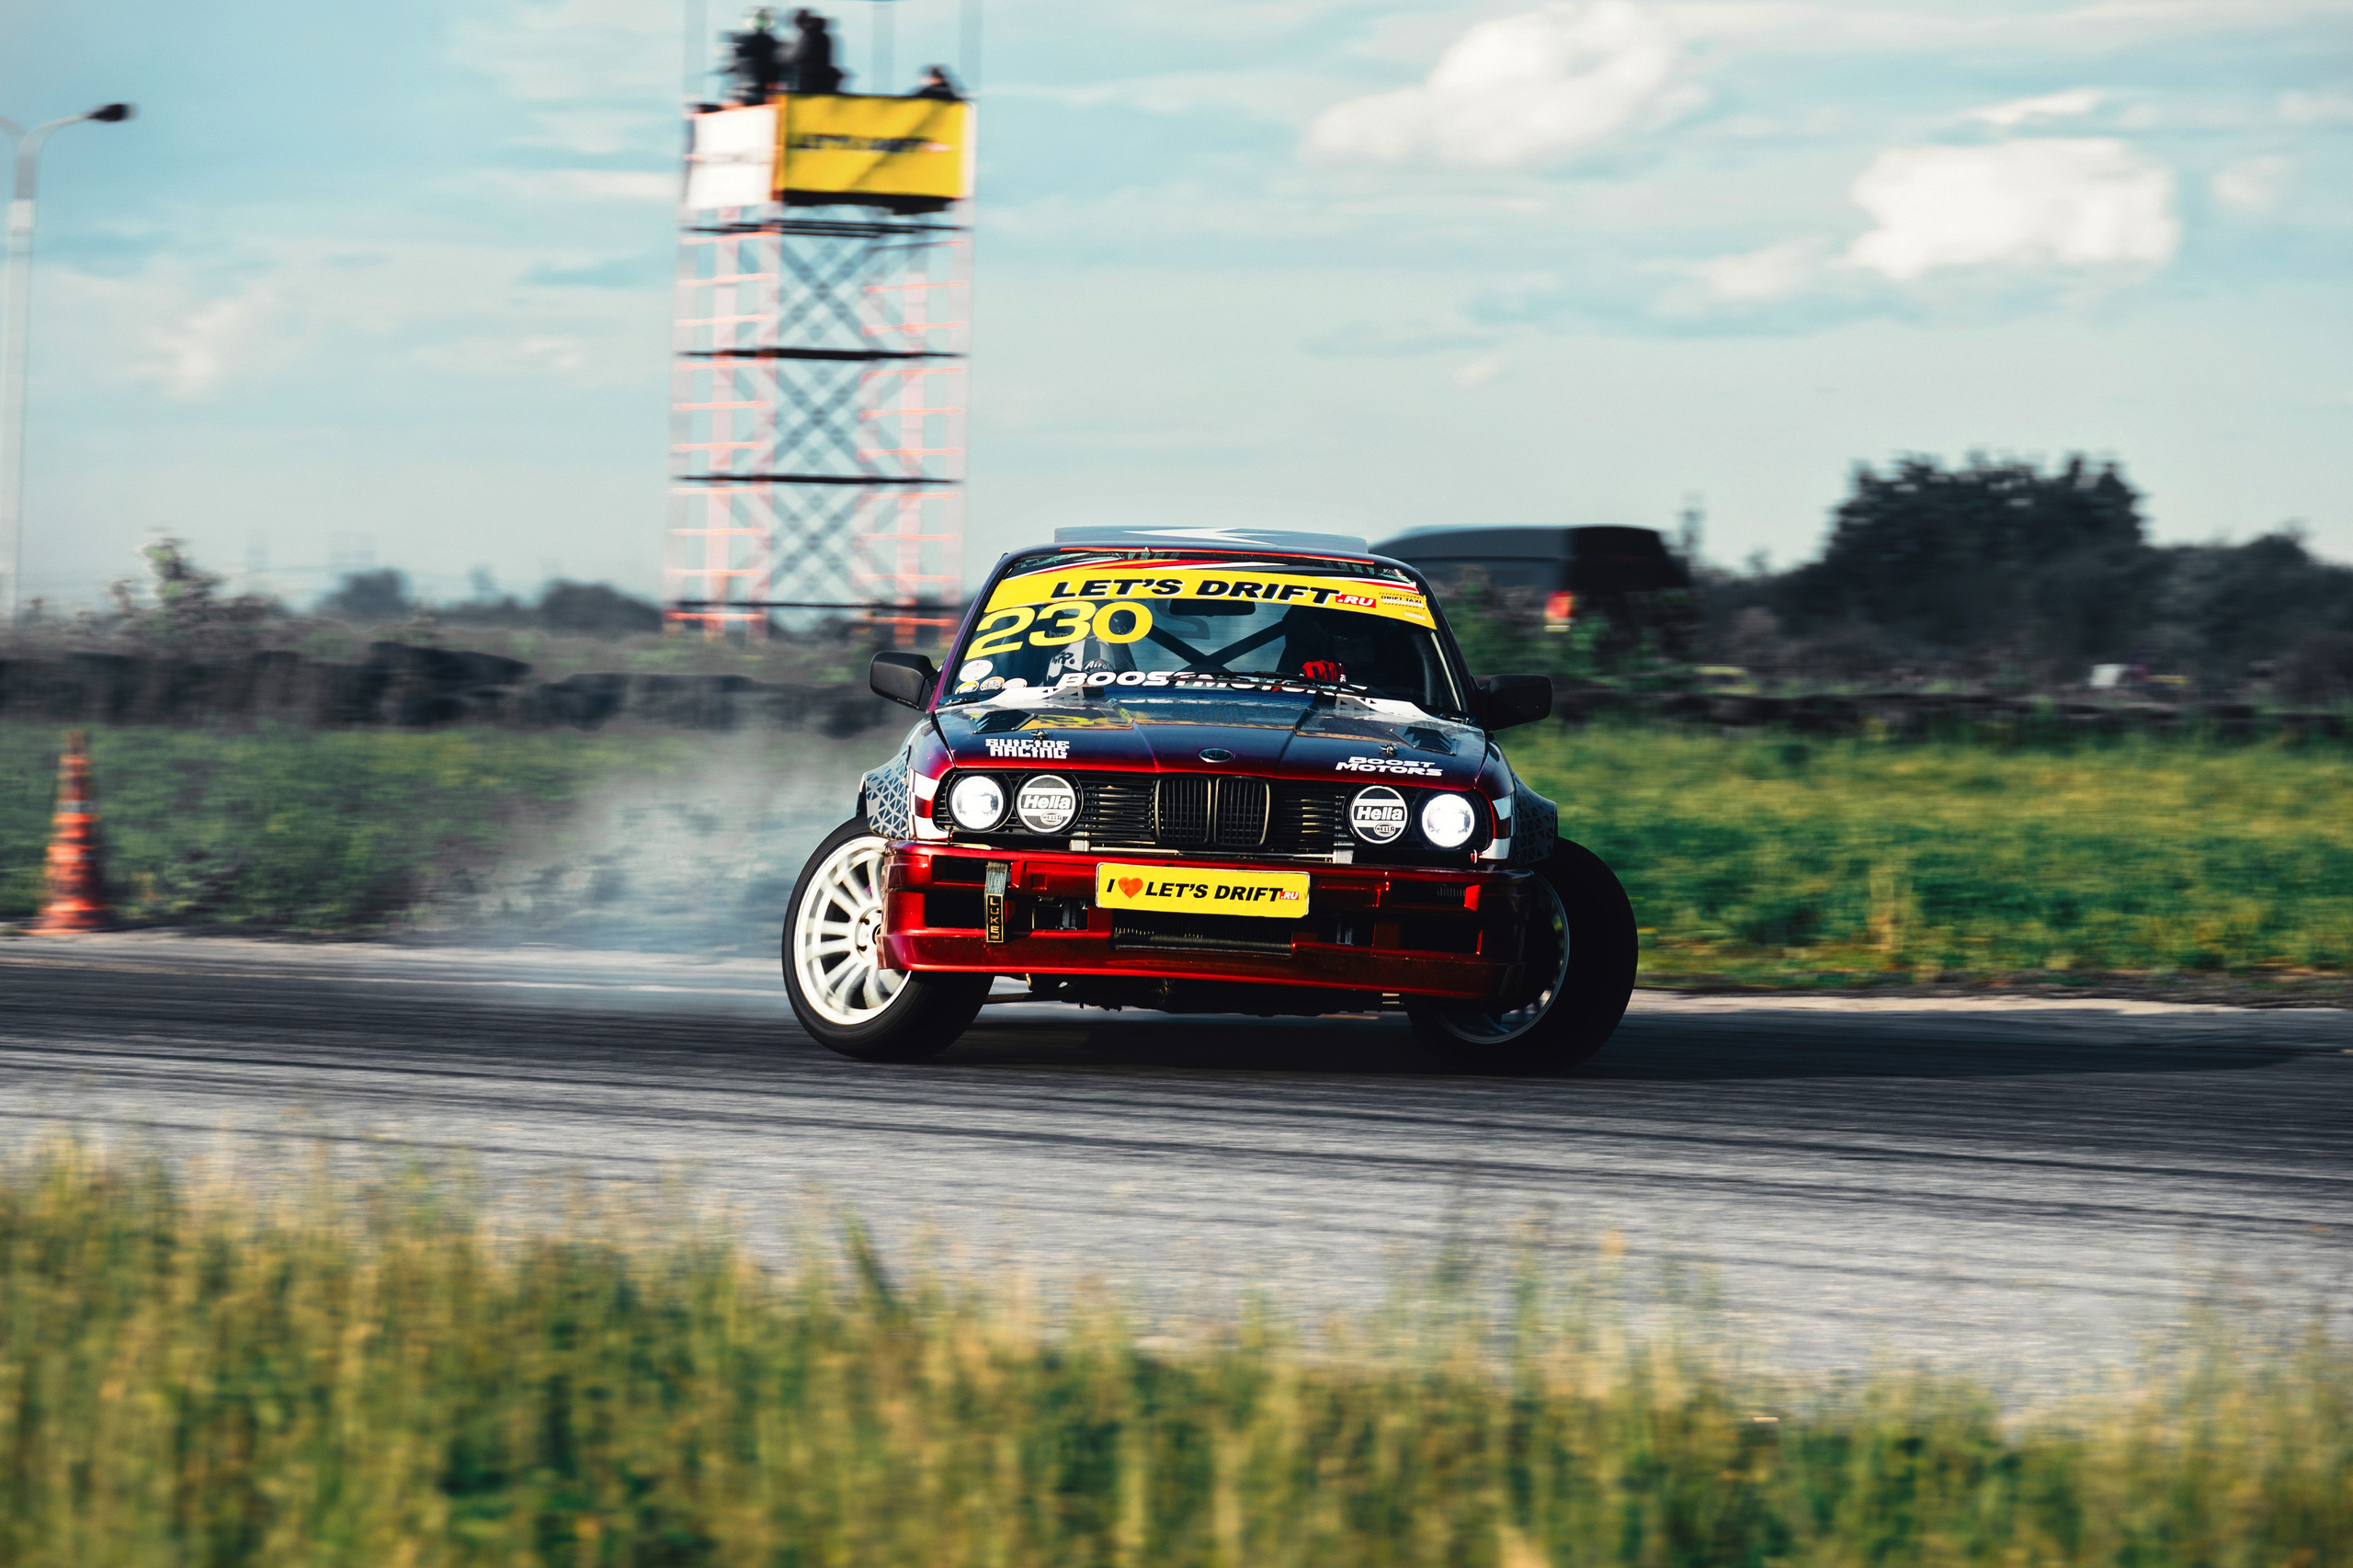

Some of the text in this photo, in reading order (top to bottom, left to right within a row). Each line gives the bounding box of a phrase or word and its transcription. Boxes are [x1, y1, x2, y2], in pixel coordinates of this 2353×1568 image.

[1051, 578, 1184, 599] LET'S
[965, 600, 1154, 661] 230
[985, 738, 1070, 749] SUICIDE
[990, 745, 1068, 759] RACING
[1335, 762, 1444, 777] MOTORS
[1347, 756, 1436, 768] BOOST
[1023, 795, 1072, 810] Hella
[1356, 806, 1404, 821] Hella
[1107, 879, 1115, 893] I
[1145, 881, 1209, 899] LET'S
[989, 897, 1000, 934] LUKE
